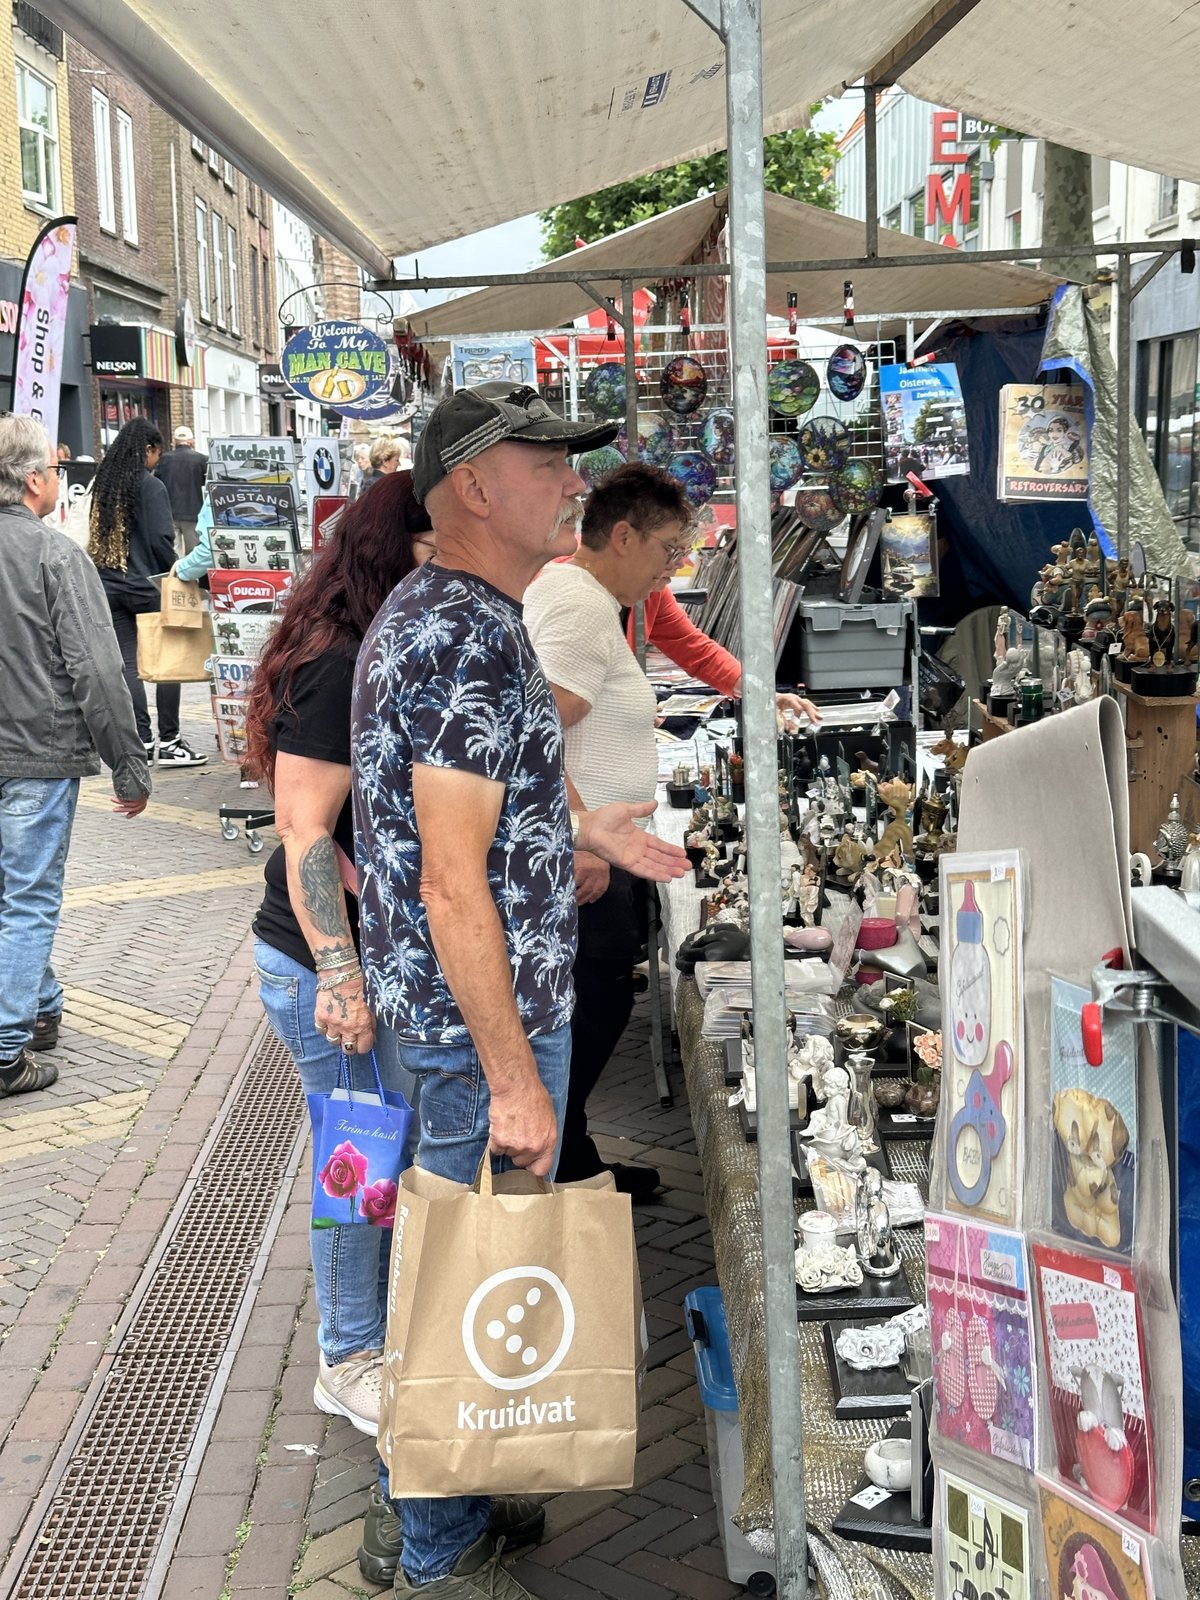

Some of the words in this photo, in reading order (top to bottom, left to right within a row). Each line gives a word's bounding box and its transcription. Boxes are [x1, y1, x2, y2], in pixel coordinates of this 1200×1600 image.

[926, 112, 972, 247] EM
[308, 324, 364, 338] Welcome
[31, 308, 49, 374] Shop
[307, 338, 327, 350] To
[334, 336, 369, 351] My
[96, 361, 137, 371] NELSON
[288, 352, 331, 378] MAN
[336, 351, 386, 375] CAVE
[261, 374, 285, 383] ONL
[1017, 396, 1045, 413] 30
[221, 444, 286, 461] Kadett
[1010, 481, 1088, 493] RETROVERSARY
[214, 493, 290, 509] MUSTANG
[234, 587, 271, 596] DUCATI
[334, 1119, 370, 1136] Terima
[370, 1126, 399, 1141] kasih
[457, 1395, 577, 1430] Kruidvat
